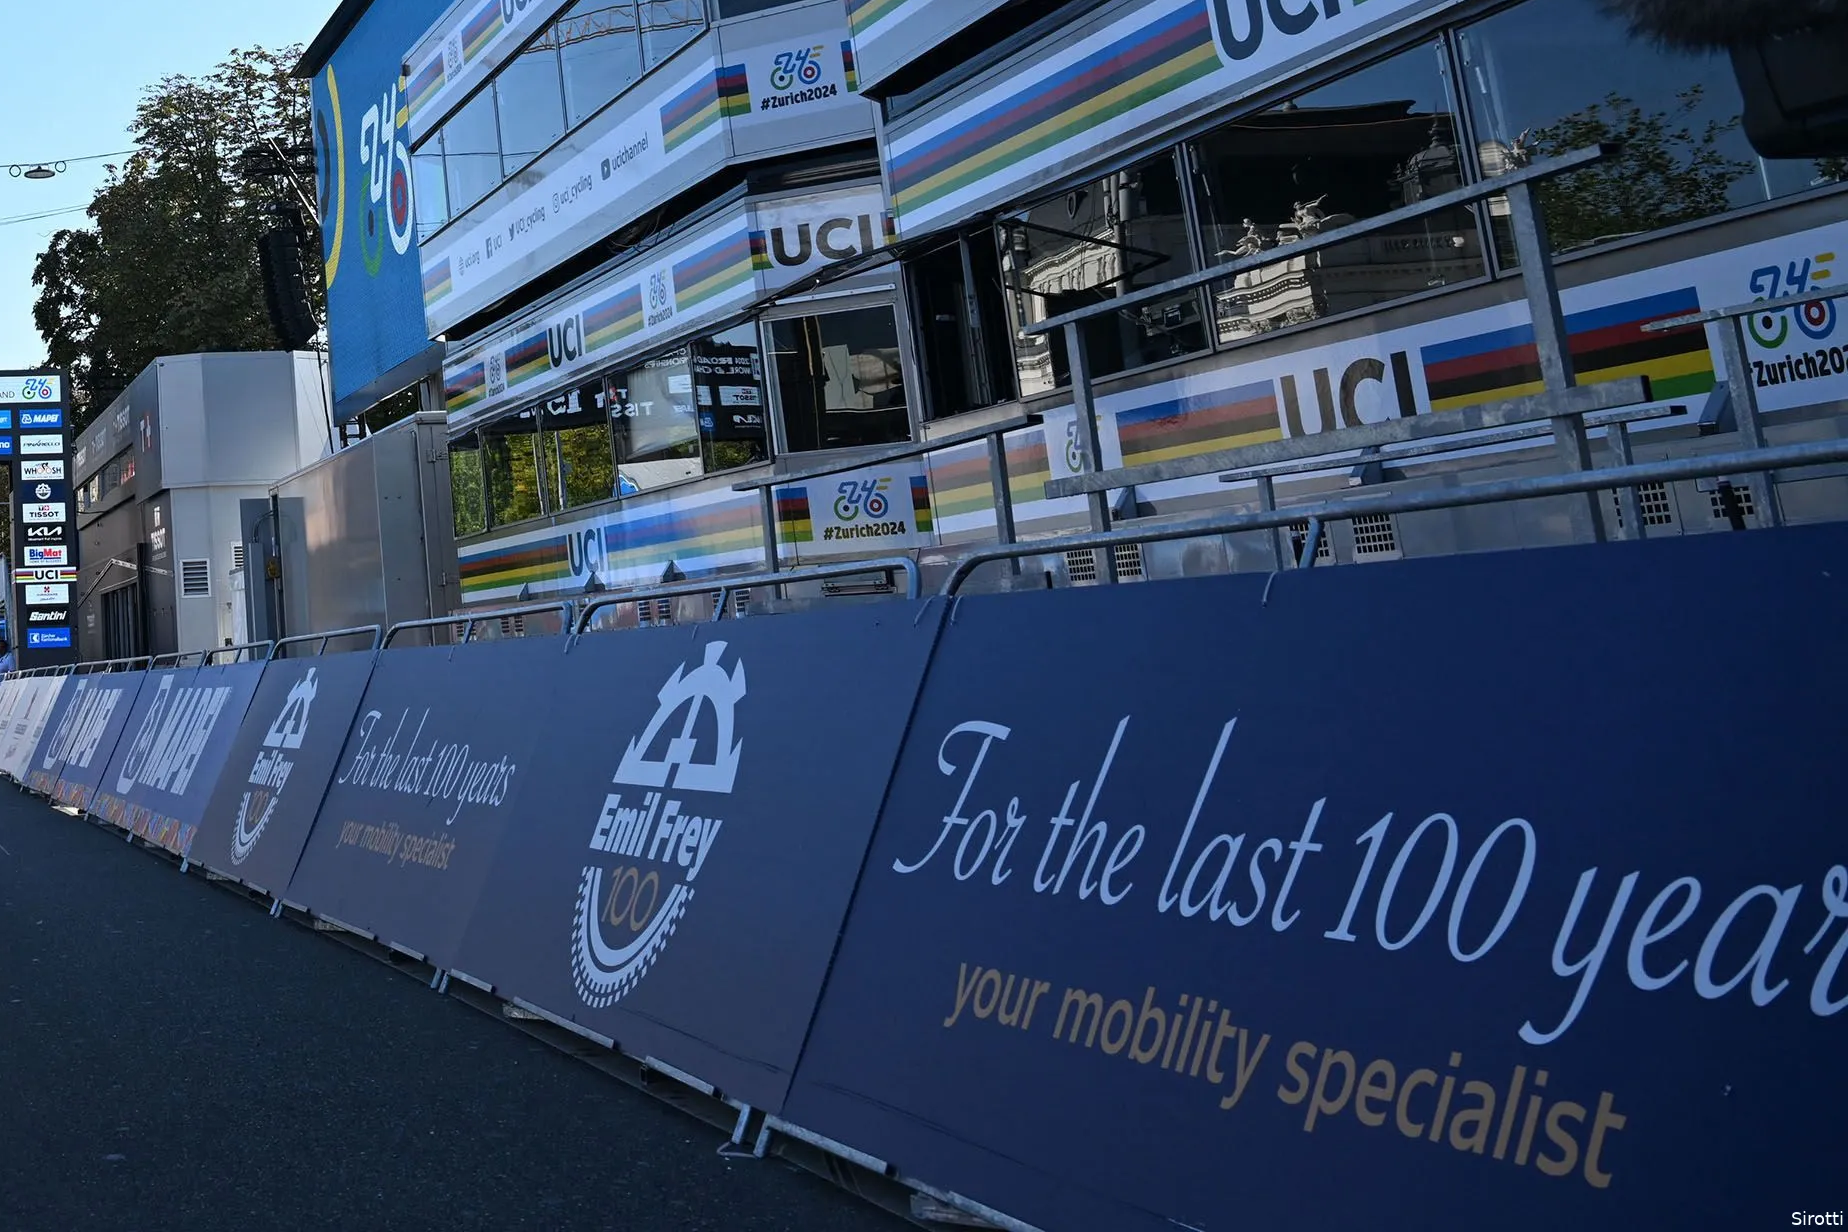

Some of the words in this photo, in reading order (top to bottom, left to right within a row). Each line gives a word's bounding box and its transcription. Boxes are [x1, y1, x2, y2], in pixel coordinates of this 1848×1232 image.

[760, 83, 838, 111] #Zurich2024
[611, 132, 648, 172] ucichannel
[770, 214, 874, 267] UCI
[547, 314, 583, 369] UCI
[1748, 343, 1848, 388] Zurich20
[32, 413, 60, 424] MAPEI
[1279, 350, 1418, 440] UCI
[29, 548, 62, 559] BigMat
[566, 527, 608, 577] UCI
[823, 521, 907, 541] #Zurich2024
[34, 569, 59, 580] UCI
[29, 610, 67, 621] Santini
[137, 686, 233, 796] MAPEI
[369, 707, 410, 791] the
[394, 707, 433, 794] last
[247, 749, 279, 786] Emil
[272, 753, 294, 796] Frey
[423, 743, 470, 799] 100
[446, 755, 516, 826] years
[589, 791, 662, 858] Emil
[647, 799, 723, 882] Frey
[600, 865, 660, 932] 100
[892, 720, 1012, 886] For
[1032, 714, 1146, 906] the
[1156, 715, 1327, 932] last
[1324, 811, 1538, 962] 100
[1517, 862, 1848, 1045] year
[942, 960, 1050, 1030] your
[1052, 985, 1270, 1111] mobility
[1276, 1035, 1628, 1189] specialist
